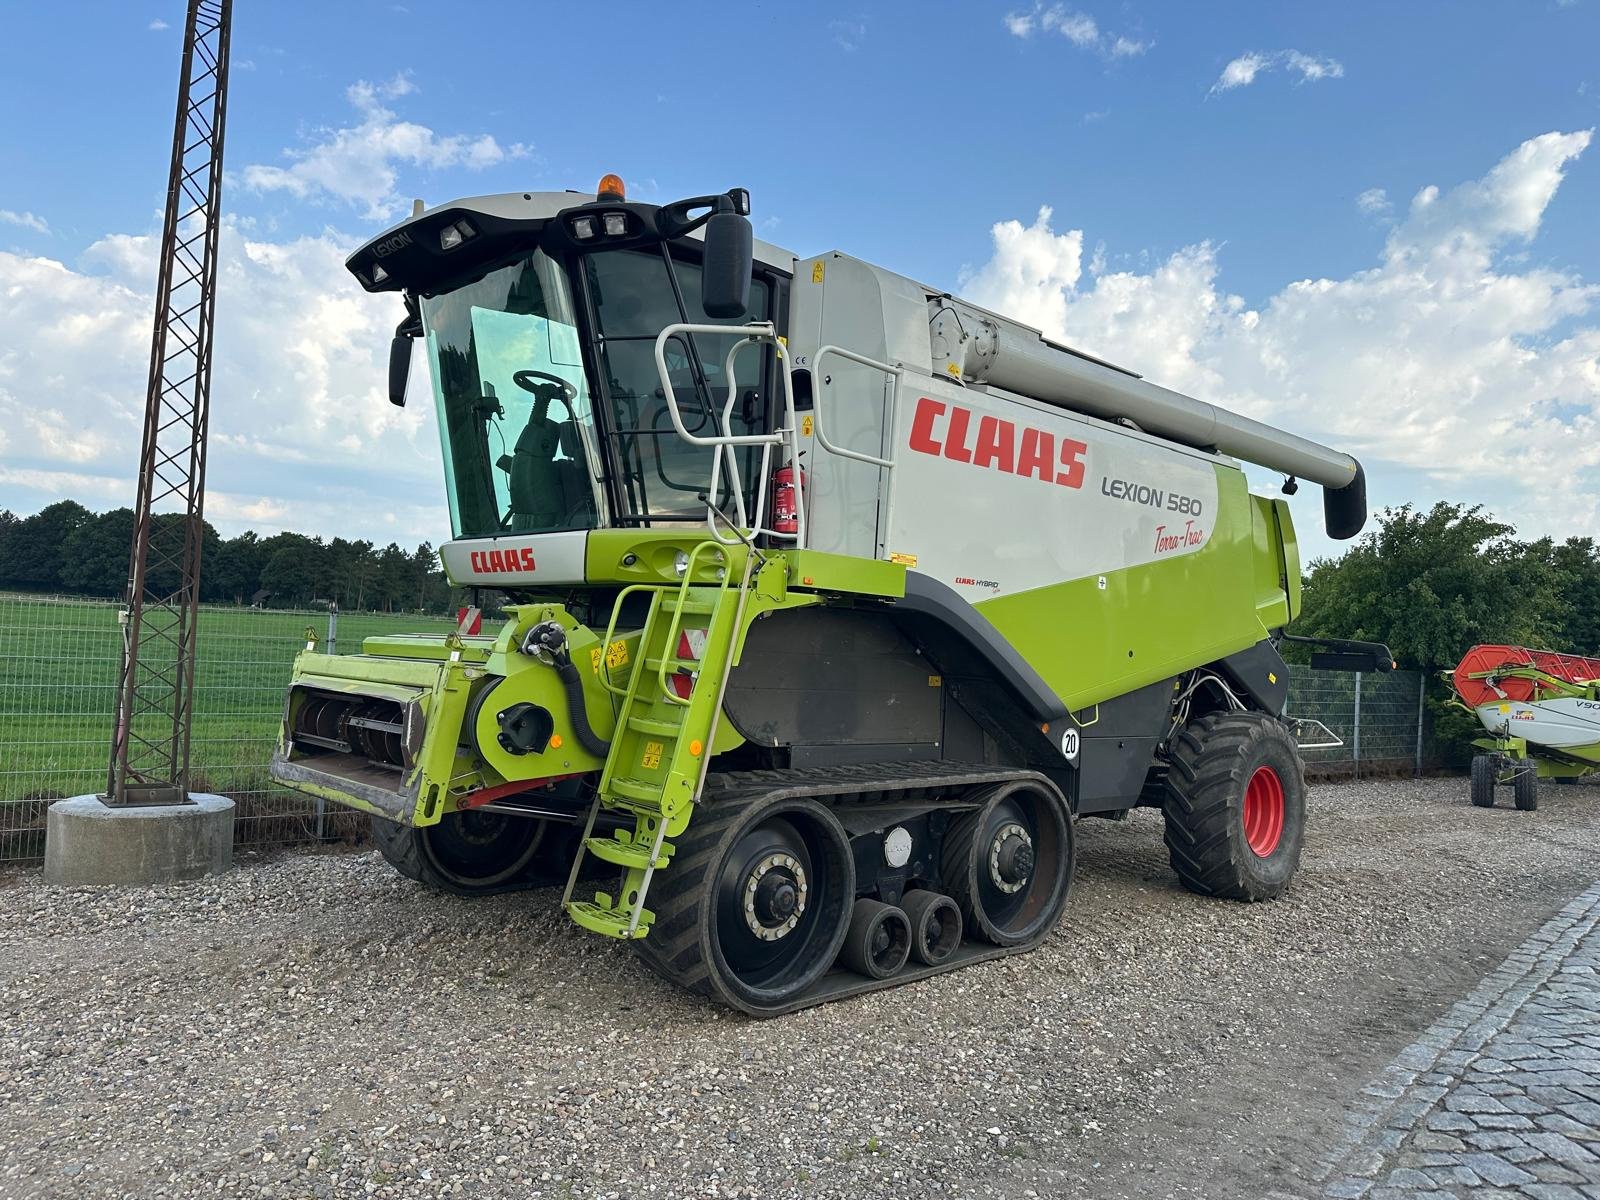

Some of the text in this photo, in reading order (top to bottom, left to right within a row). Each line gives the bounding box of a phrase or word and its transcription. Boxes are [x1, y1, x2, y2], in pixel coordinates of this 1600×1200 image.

[371, 231, 414, 258] LEXION
[909, 397, 1088, 490] CLAAS
[1101, 476, 1203, 517] LEXION 580
[1153, 519, 1204, 554] Terra-Trac
[470, 548, 536, 574] CLAAS
[955, 577, 976, 586] CLAAS
[1065, 733, 1076, 754] 20
